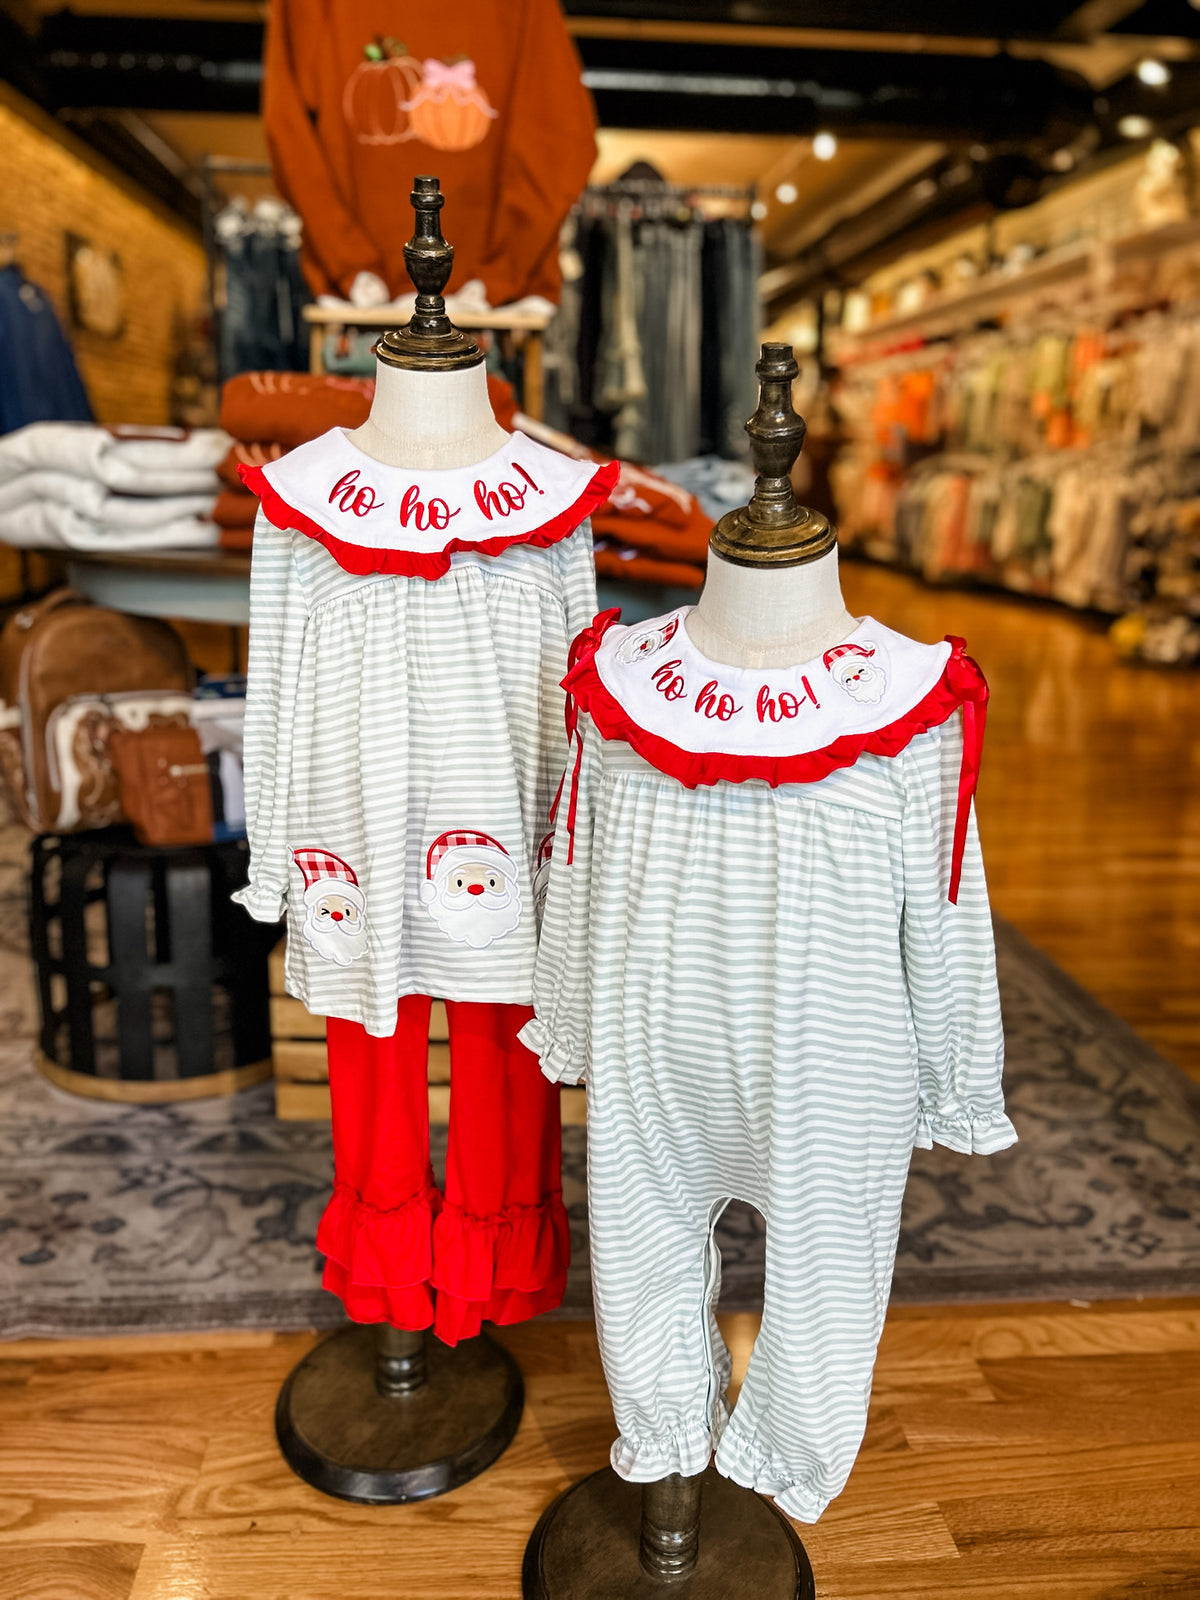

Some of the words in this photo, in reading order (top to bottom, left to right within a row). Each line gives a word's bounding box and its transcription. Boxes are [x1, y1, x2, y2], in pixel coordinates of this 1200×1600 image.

[329, 470, 385, 517] ho
[400, 485, 461, 531] ho
[474, 462, 545, 521] ho!
[651, 659, 687, 702] ho
[695, 680, 743, 721] ho
[756, 675, 821, 723] ho!
